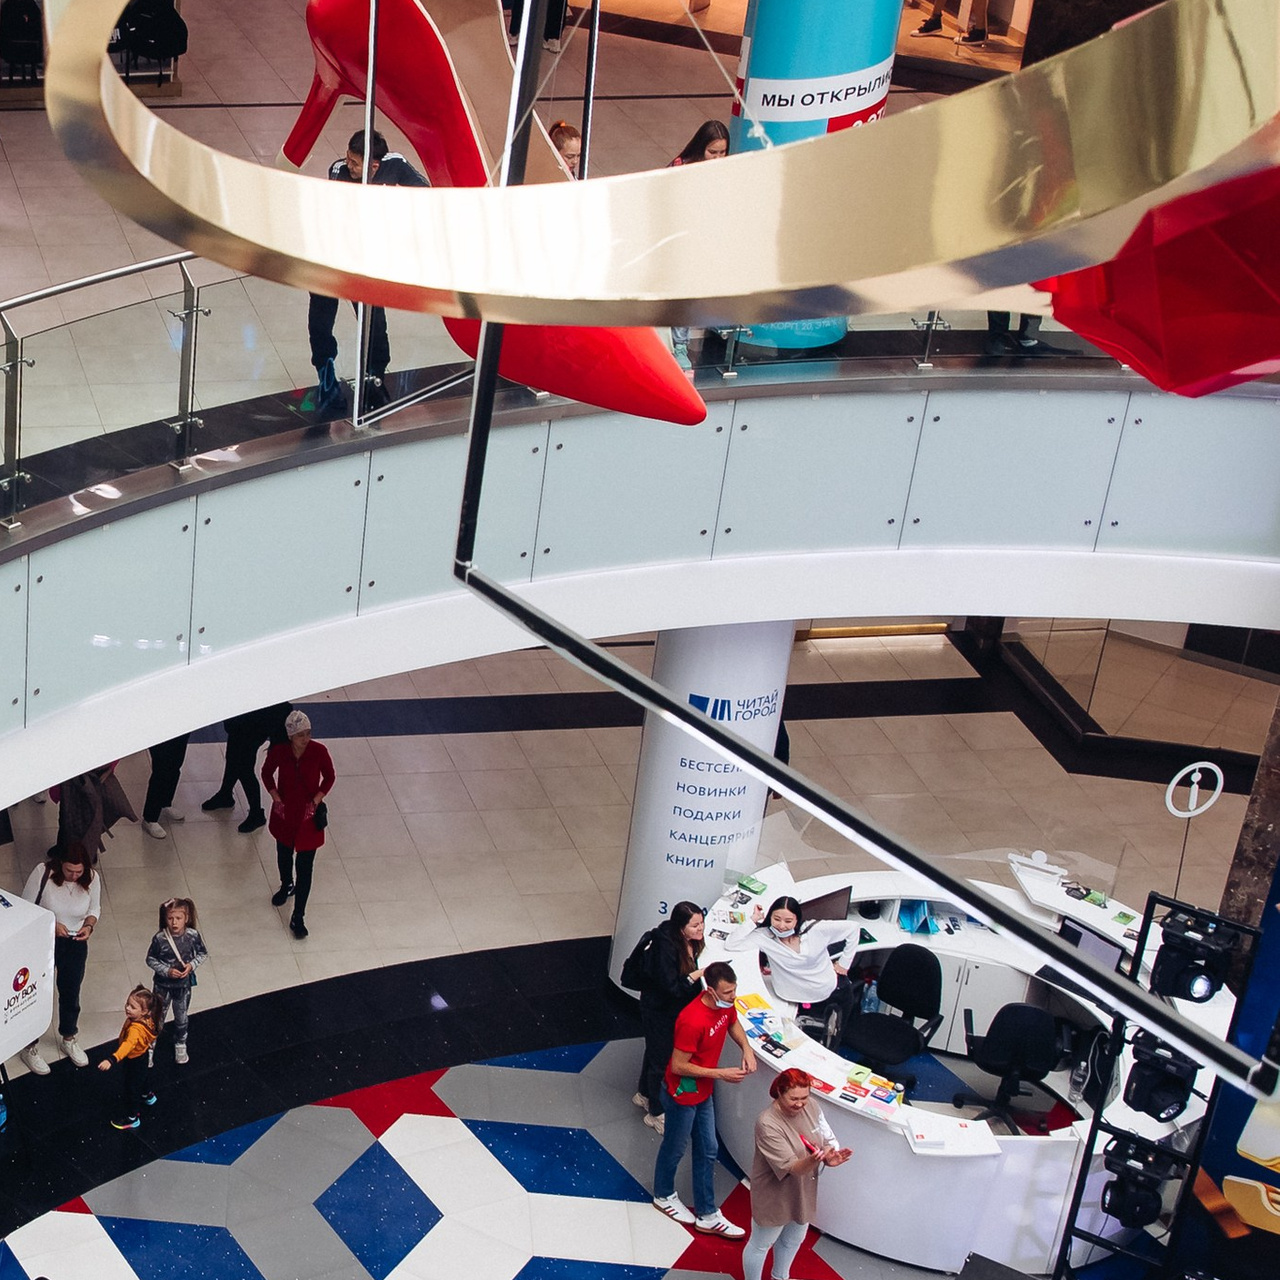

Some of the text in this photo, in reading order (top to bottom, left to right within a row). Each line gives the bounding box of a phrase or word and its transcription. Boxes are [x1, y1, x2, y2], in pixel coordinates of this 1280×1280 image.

[761, 66, 893, 107] МЫ ОТКРЫЛИ
[736, 688, 779, 710] ЧИТАЙ
[734, 703, 777, 721] ГОРОД
[676, 782, 747, 798] НОВИНКИ
[672, 806, 742, 822] ПОДАРКИ
[669, 827, 755, 846] КАНЦЕЛЯРИЯ
[666, 853, 715, 869] КНИГИ
[3, 992, 21, 1011] JOY
[21, 981, 37, 999] BOX
